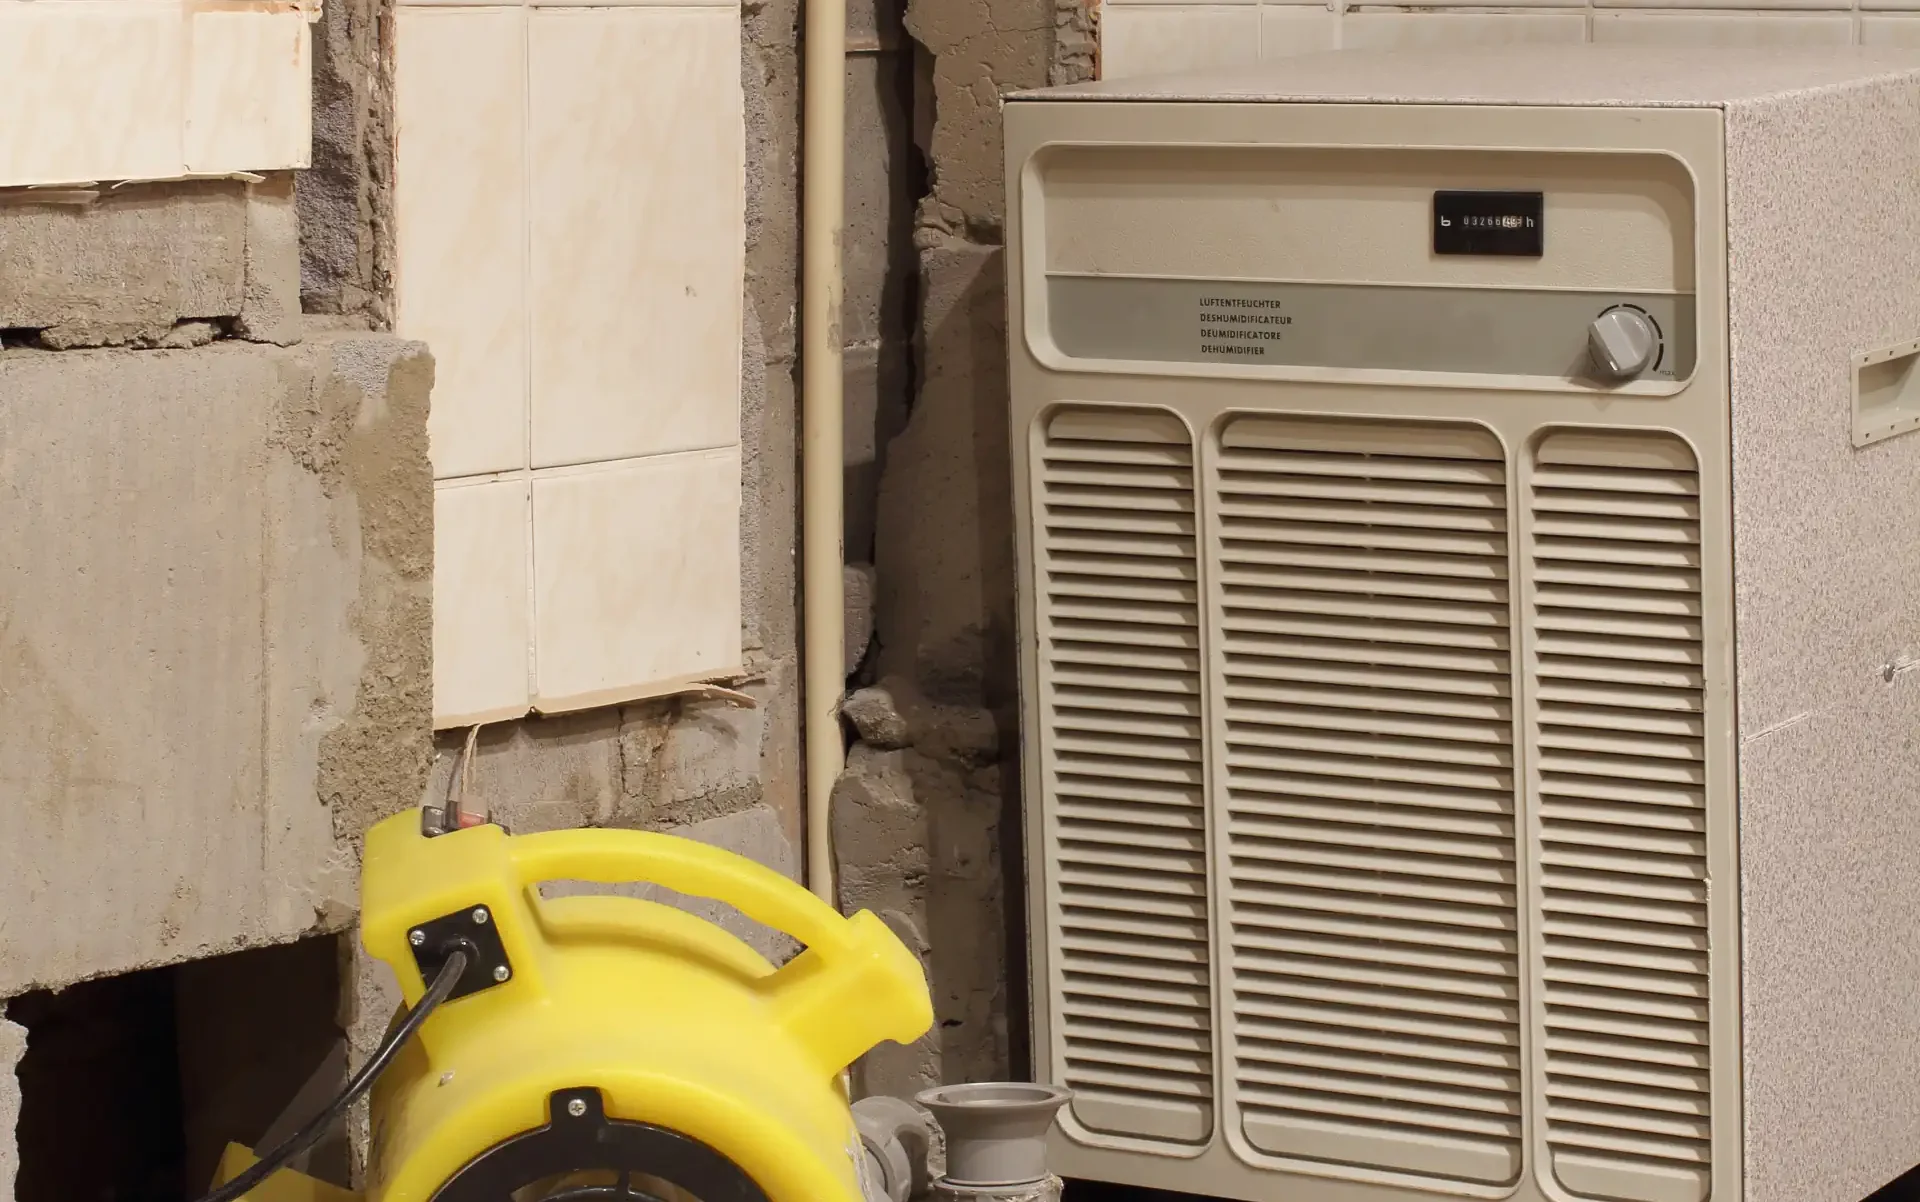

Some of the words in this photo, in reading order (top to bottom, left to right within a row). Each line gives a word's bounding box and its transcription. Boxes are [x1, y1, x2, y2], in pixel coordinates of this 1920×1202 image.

[1526, 216, 1534, 228] h
[1199, 298, 1281, 309] LUFTENTFEUCHTER
[1200, 313, 1292, 325] DESHUMIDIFICATEUR
[1200, 329, 1281, 340] DEUMIDIFICATORE
[1201, 344, 1265, 355] DEHUMIDIFIER
